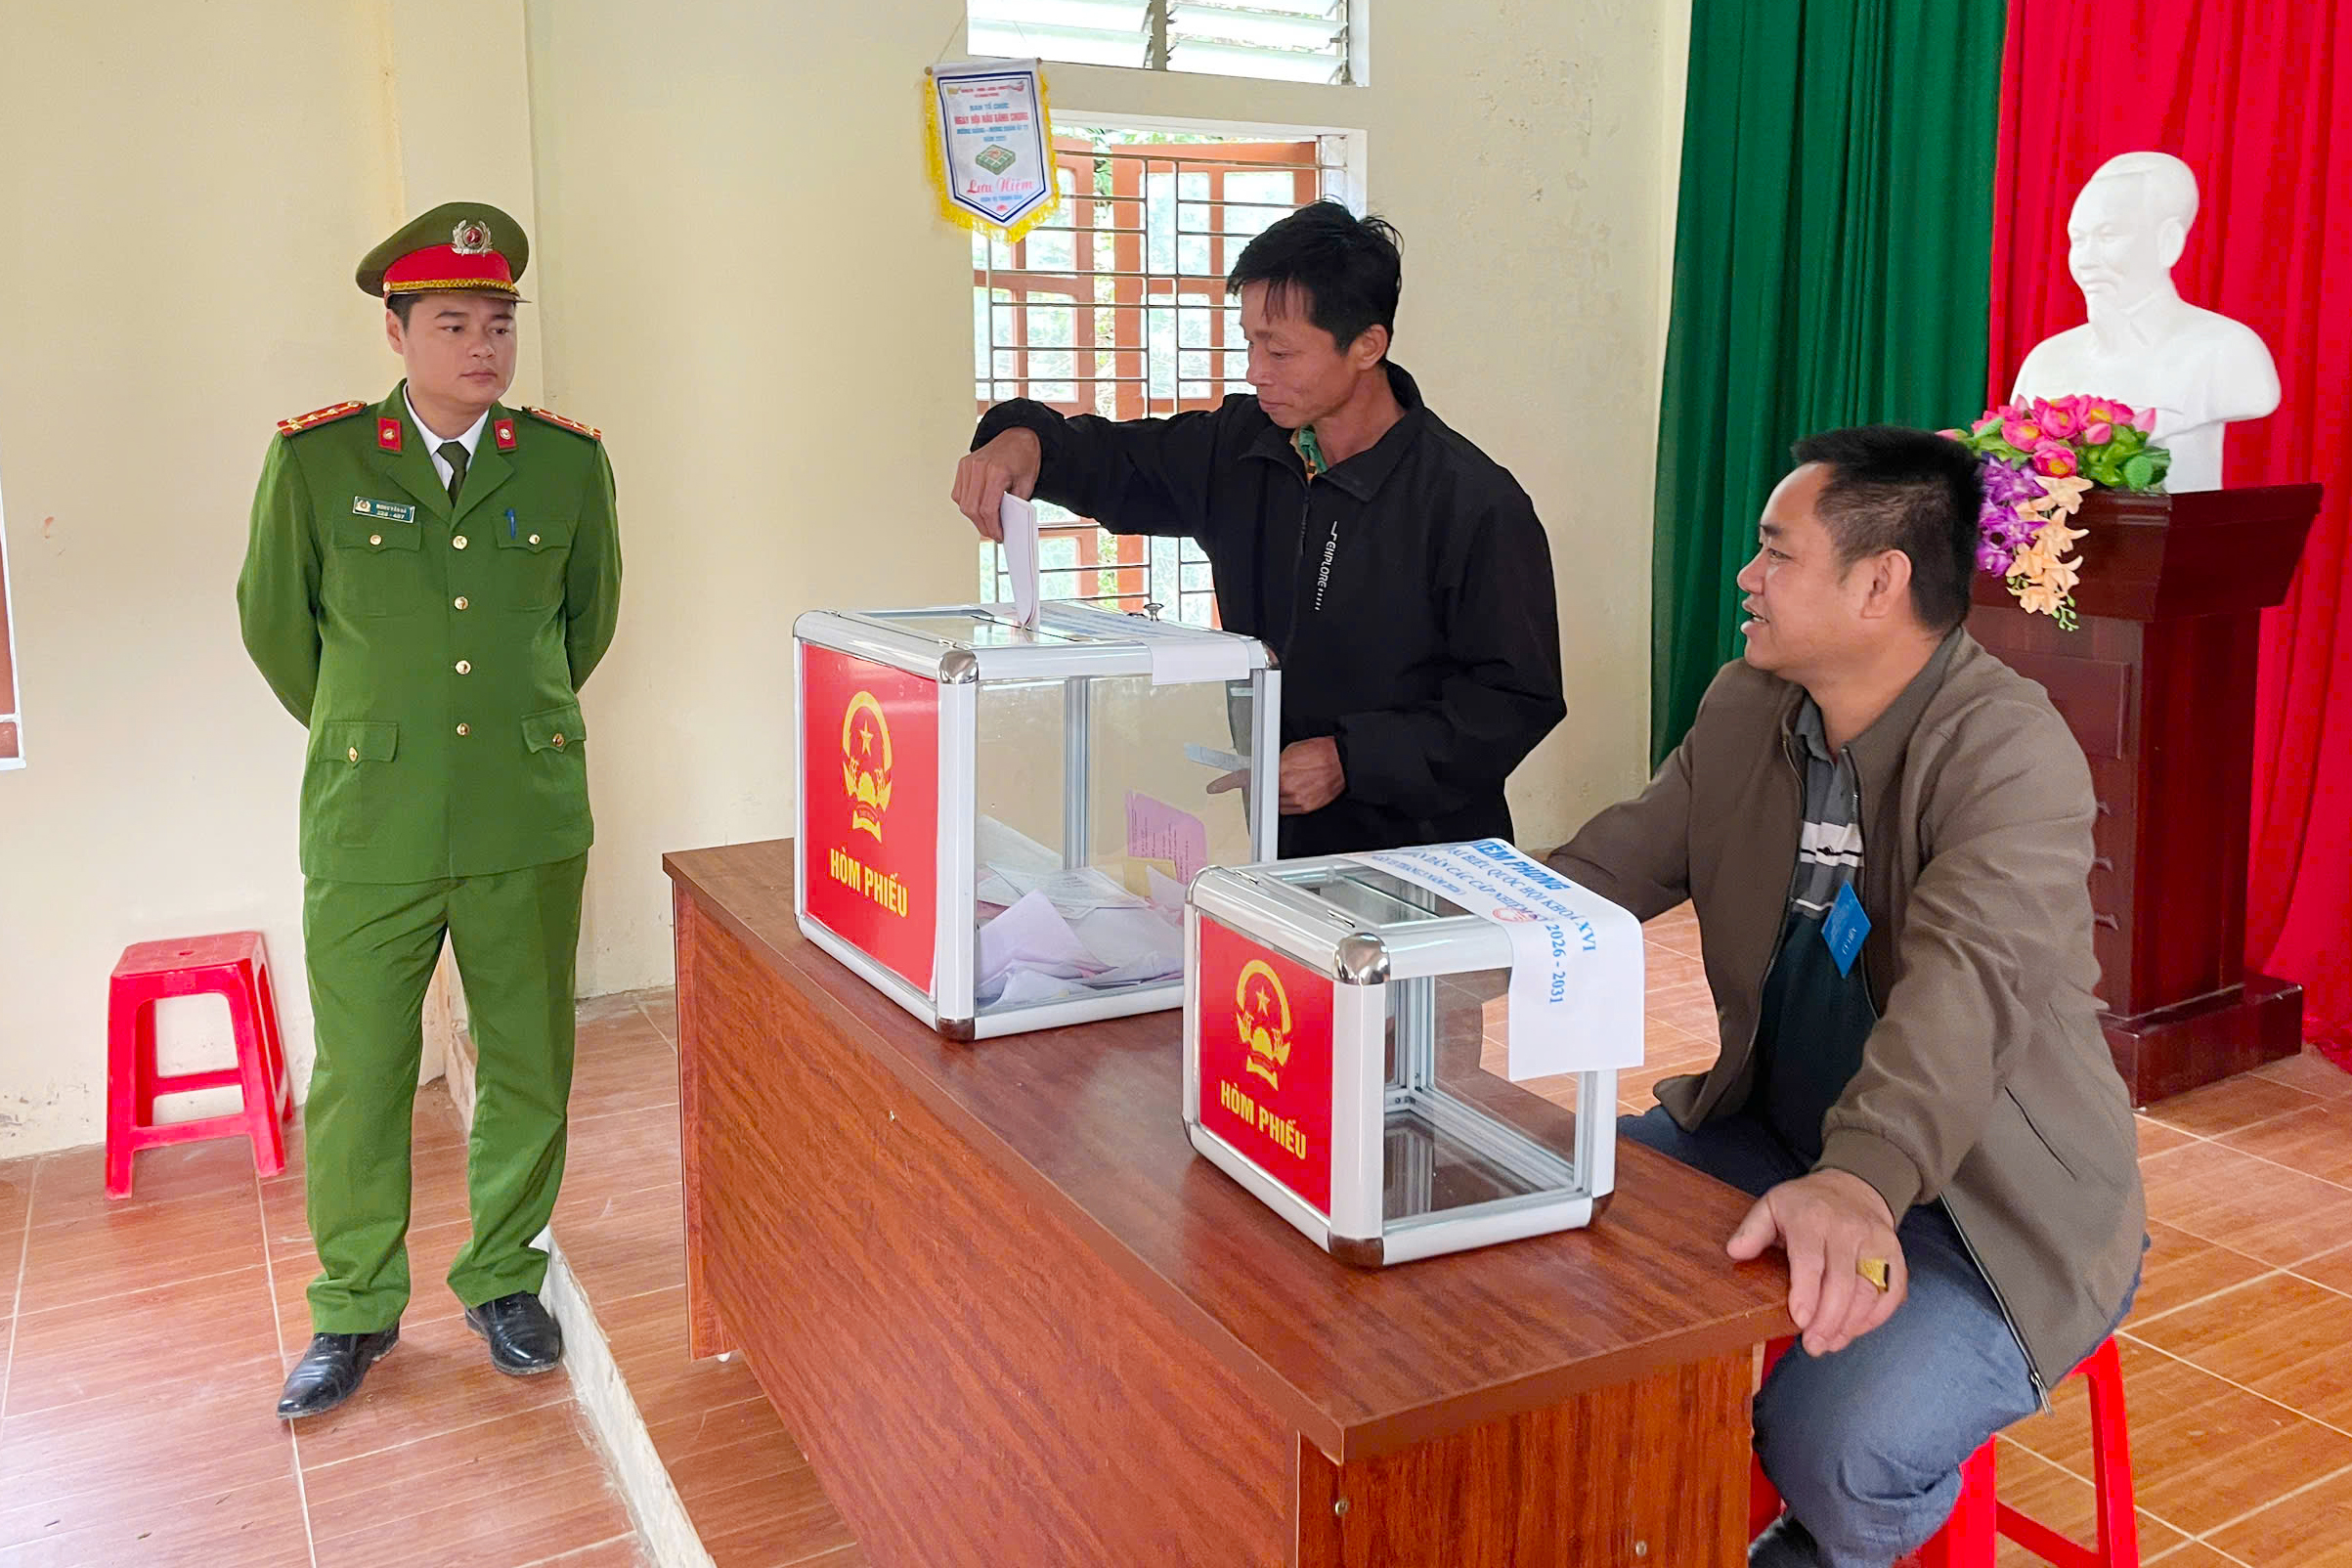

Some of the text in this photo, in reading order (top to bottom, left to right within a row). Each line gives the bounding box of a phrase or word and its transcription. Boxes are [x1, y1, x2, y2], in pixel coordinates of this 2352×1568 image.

[831, 847, 908, 918] HÒM PHIẾU
[1545, 924, 1566, 957] 2026
[1575, 921, 1596, 951] XVI
[1548, 972, 1566, 1004] 2031
[1221, 1079, 1306, 1160] HÒM PHIẾU
